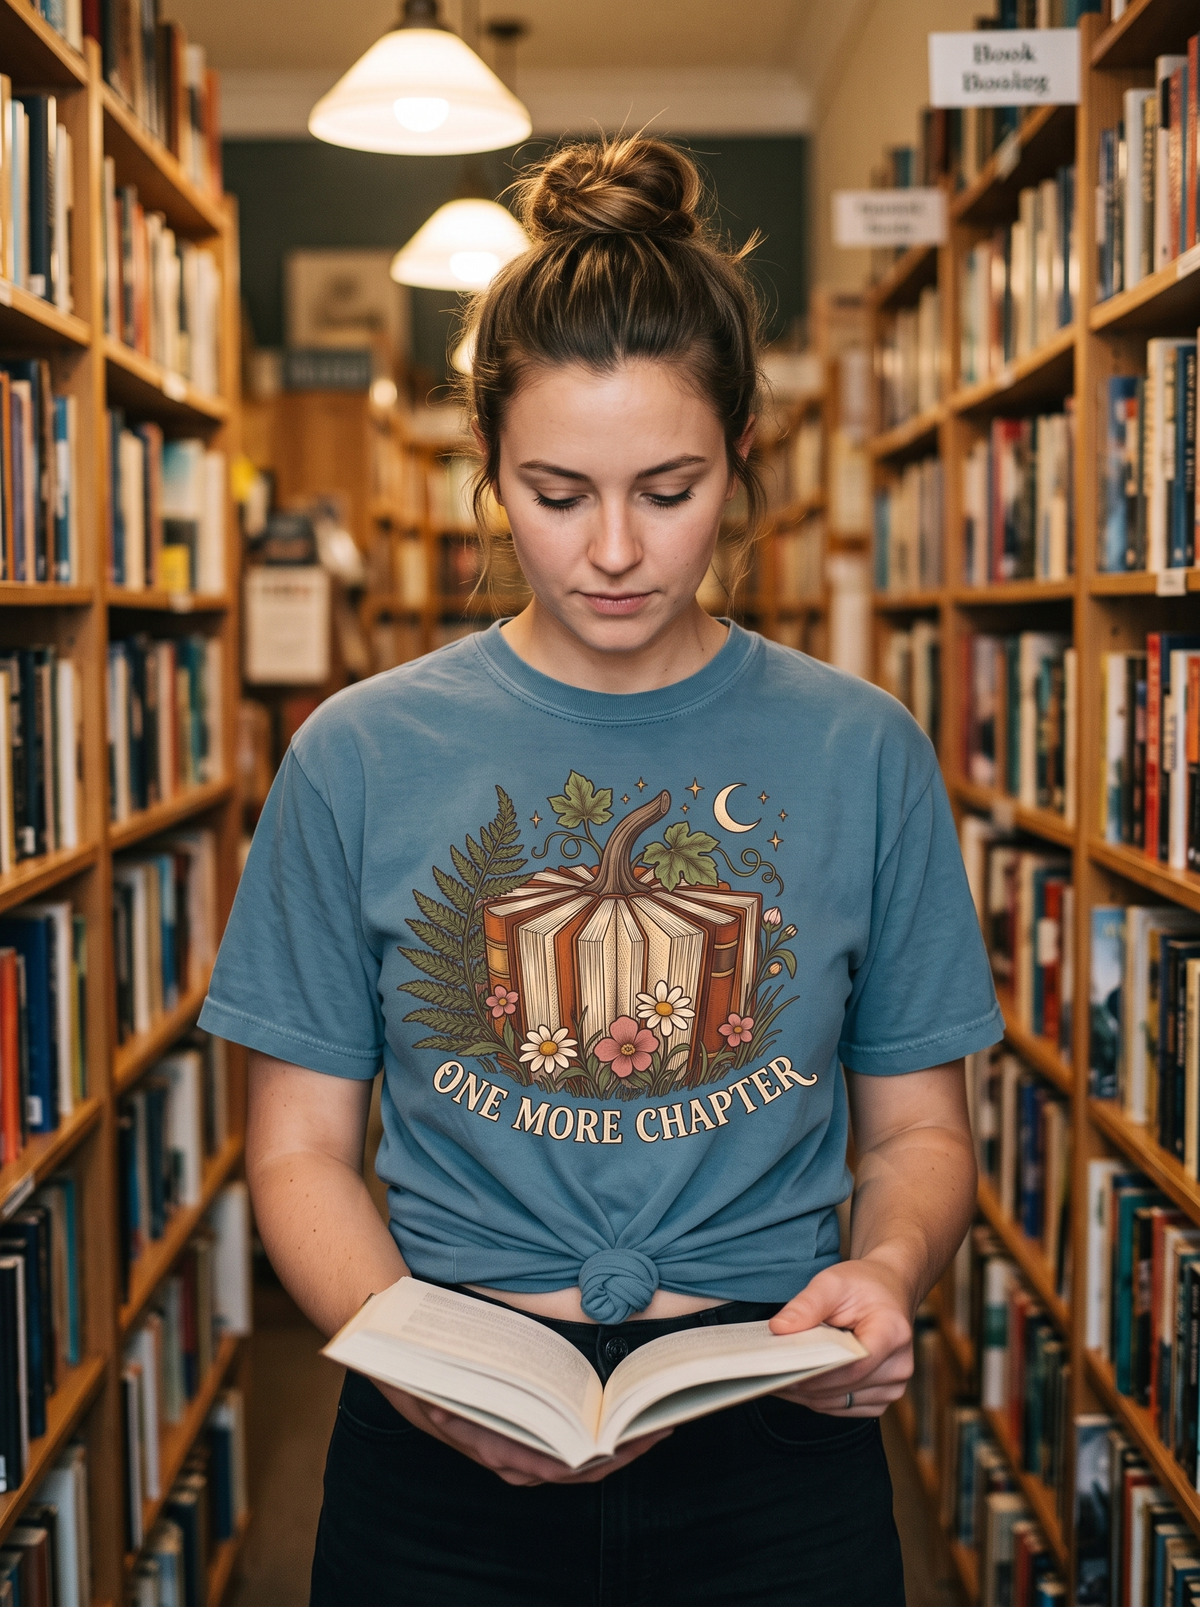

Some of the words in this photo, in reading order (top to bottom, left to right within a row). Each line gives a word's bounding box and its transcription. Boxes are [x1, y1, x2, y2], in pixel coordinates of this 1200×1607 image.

[432, 1059, 509, 1122] ONE
[511, 1097, 624, 1145] MORE
[634, 1055, 819, 1144] CHAPTER
